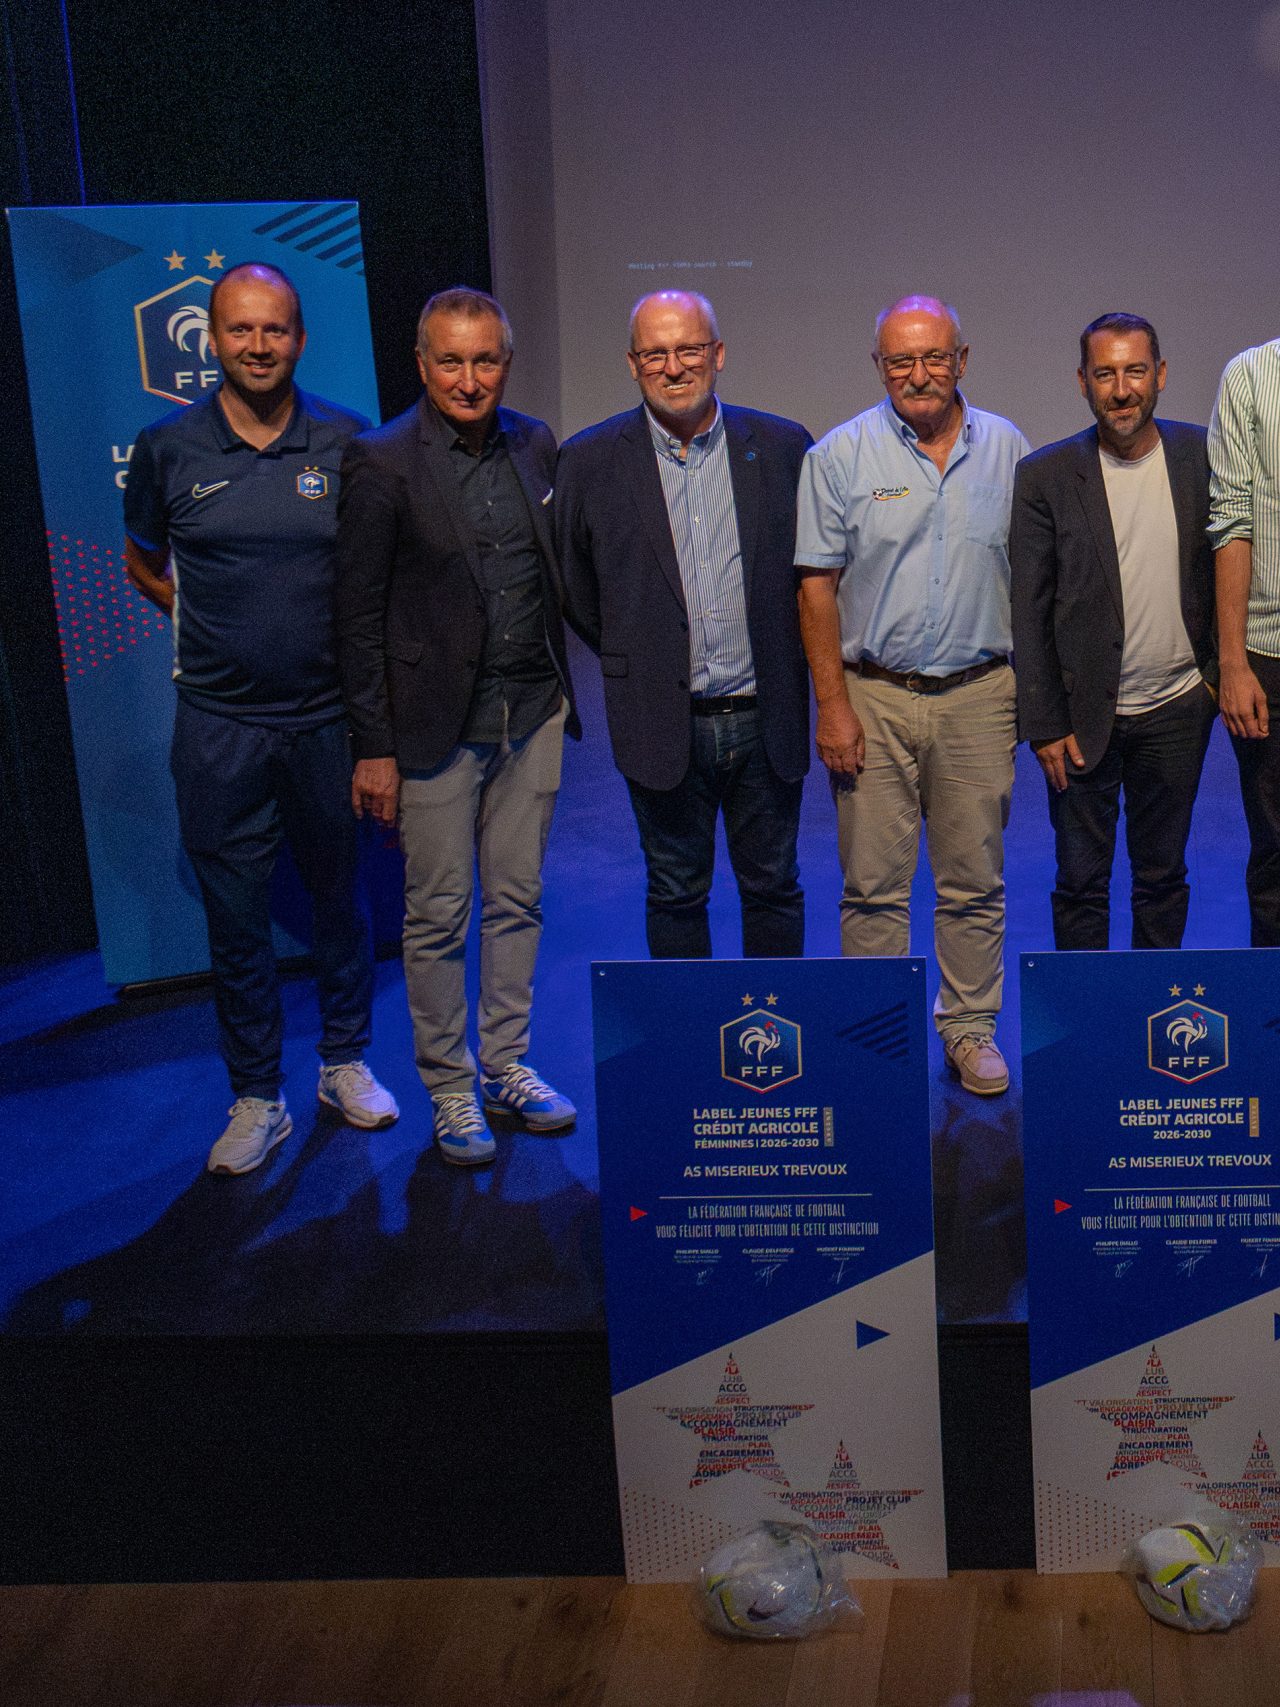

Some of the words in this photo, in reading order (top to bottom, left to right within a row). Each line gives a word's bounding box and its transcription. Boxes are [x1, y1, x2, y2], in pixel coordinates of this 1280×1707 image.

[174, 369, 219, 390] FF
[1168, 1056, 1211, 1069] FFF
[741, 1066, 784, 1078] FFF
[1120, 1098, 1162, 1111] LABEL
[1166, 1098, 1217, 1110] JEUNES
[1220, 1097, 1244, 1109] FFF
[694, 1108, 737, 1120] LABEL
[740, 1107, 791, 1119] JEUNES
[794, 1106, 818, 1118] FFF
[1120, 1111, 1171, 1127] CRÉDIT
[1174, 1112, 1245, 1126] AGRICOLE
[694, 1120, 745, 1136] CRÉDIT
[748, 1121, 819, 1135] AGRICOLE
[1153, 1129, 1212, 1140] 2026-2030
[695, 1138, 754, 1149] FÉMININES
[760, 1138, 819, 1148] 2026-2030
[1109, 1156, 1127, 1169] AS
[1130, 1155, 1204, 1168] MISERIEUX
[1207, 1154, 1272, 1167] TREVOUX
[684, 1165, 702, 1178] AS
[705, 1165, 779, 1177] MISERIEUX
[782, 1163, 848, 1176] TREVOUX
[1114, 1197, 1124, 1210] LA
[1126, 1195, 1173, 1209] FÉDÉRATION
[1175, 1194, 1218, 1210] FRANÇAISE
[1221, 1195, 1231, 1208] DE
[1233, 1194, 1271, 1208] FOOTBALL
[688, 1206, 698, 1219] LA
[700, 1204, 747, 1219] FÉDÉRATION
[750, 1204, 793, 1220] FRANÇAISE
[796, 1204, 806, 1217] DE
[808, 1204, 846, 1217] FOOTBALL
[1081, 1216, 1102, 1230] VOUS
[1104, 1214, 1138, 1229] FÉLICITE
[1140, 1215, 1161, 1229] POUR
[1163, 1214, 1214, 1229] L'OBTENTION
[1216, 1214, 1227, 1228] DE
[1229, 1213, 1252, 1227] CETTE
[656, 1225, 677, 1239] VOUS
[679, 1223, 713, 1238] FÉLICITE
[715, 1225, 736, 1238] POUR
[739, 1224, 789, 1238] L'OBTENTION
[791, 1223, 802, 1237] DE
[804, 1223, 827, 1237] CETTE
[829, 1222, 879, 1237] DISTINCTION
[1101, 1410, 1208, 1421] ACCOMPAGNEMENT
[680, 1418, 788, 1428] ACCOMPAGNEMENT
[846, 1496, 883, 1504] PROJET
